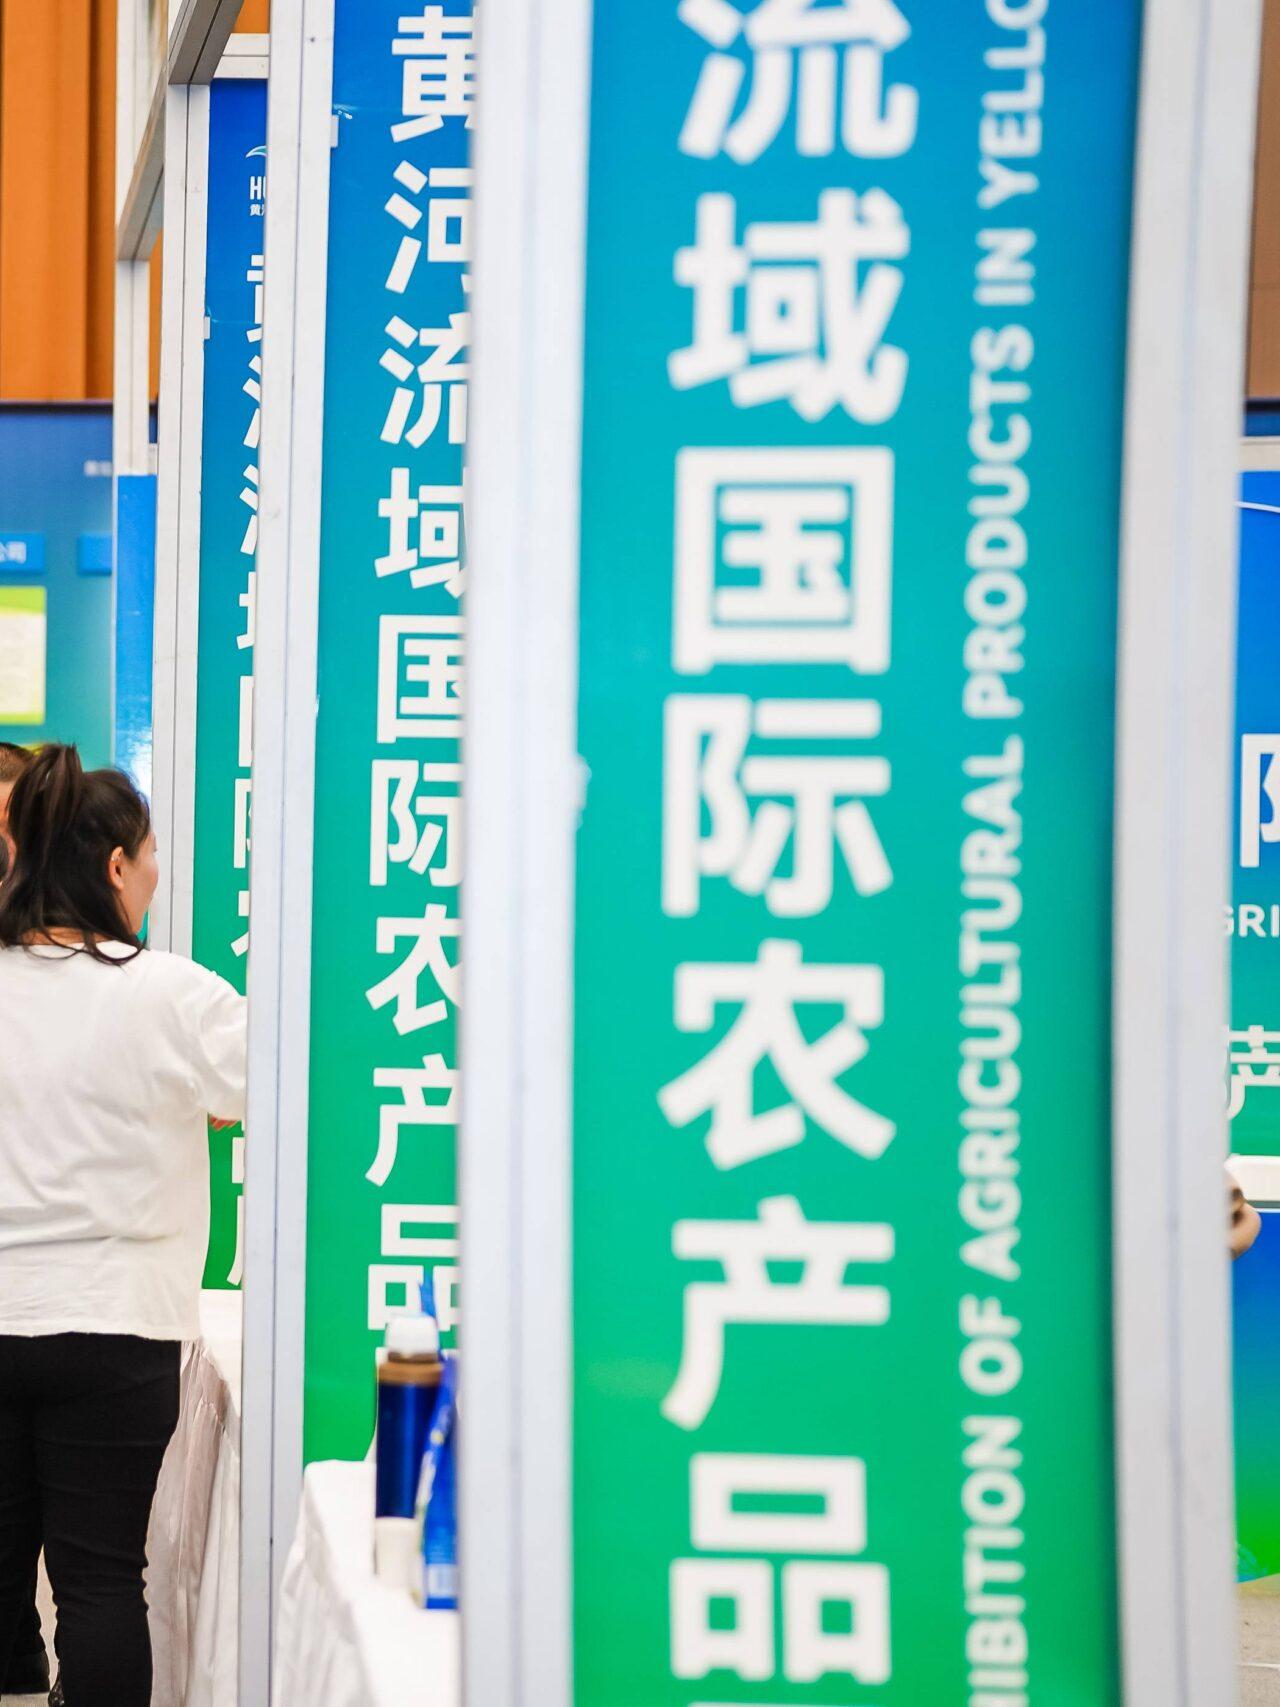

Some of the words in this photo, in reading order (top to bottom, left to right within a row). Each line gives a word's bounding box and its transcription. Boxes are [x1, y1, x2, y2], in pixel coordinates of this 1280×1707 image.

[973, 227, 1036, 307] IN
[963, 324, 1034, 719] PRODUCTS
[958, 736, 1023, 1281] AGRICULTURAL
[959, 1294, 1023, 1397] OF
